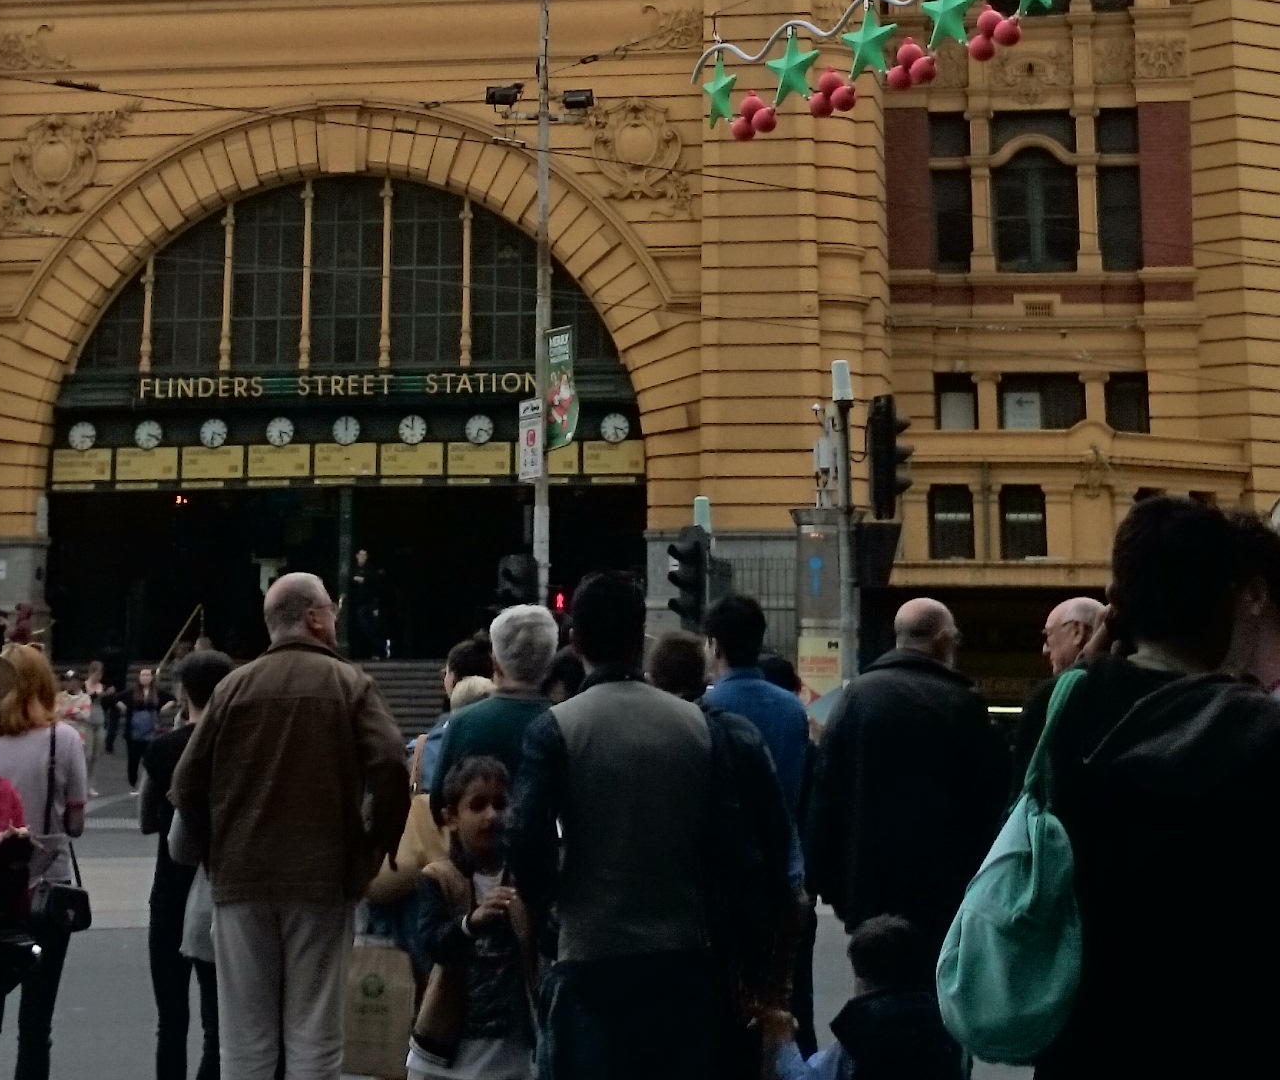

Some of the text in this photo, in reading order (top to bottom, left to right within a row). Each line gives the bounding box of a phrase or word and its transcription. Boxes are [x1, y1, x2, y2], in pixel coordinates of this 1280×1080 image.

[140, 372, 537, 399] FLINDERS STREET STATION
